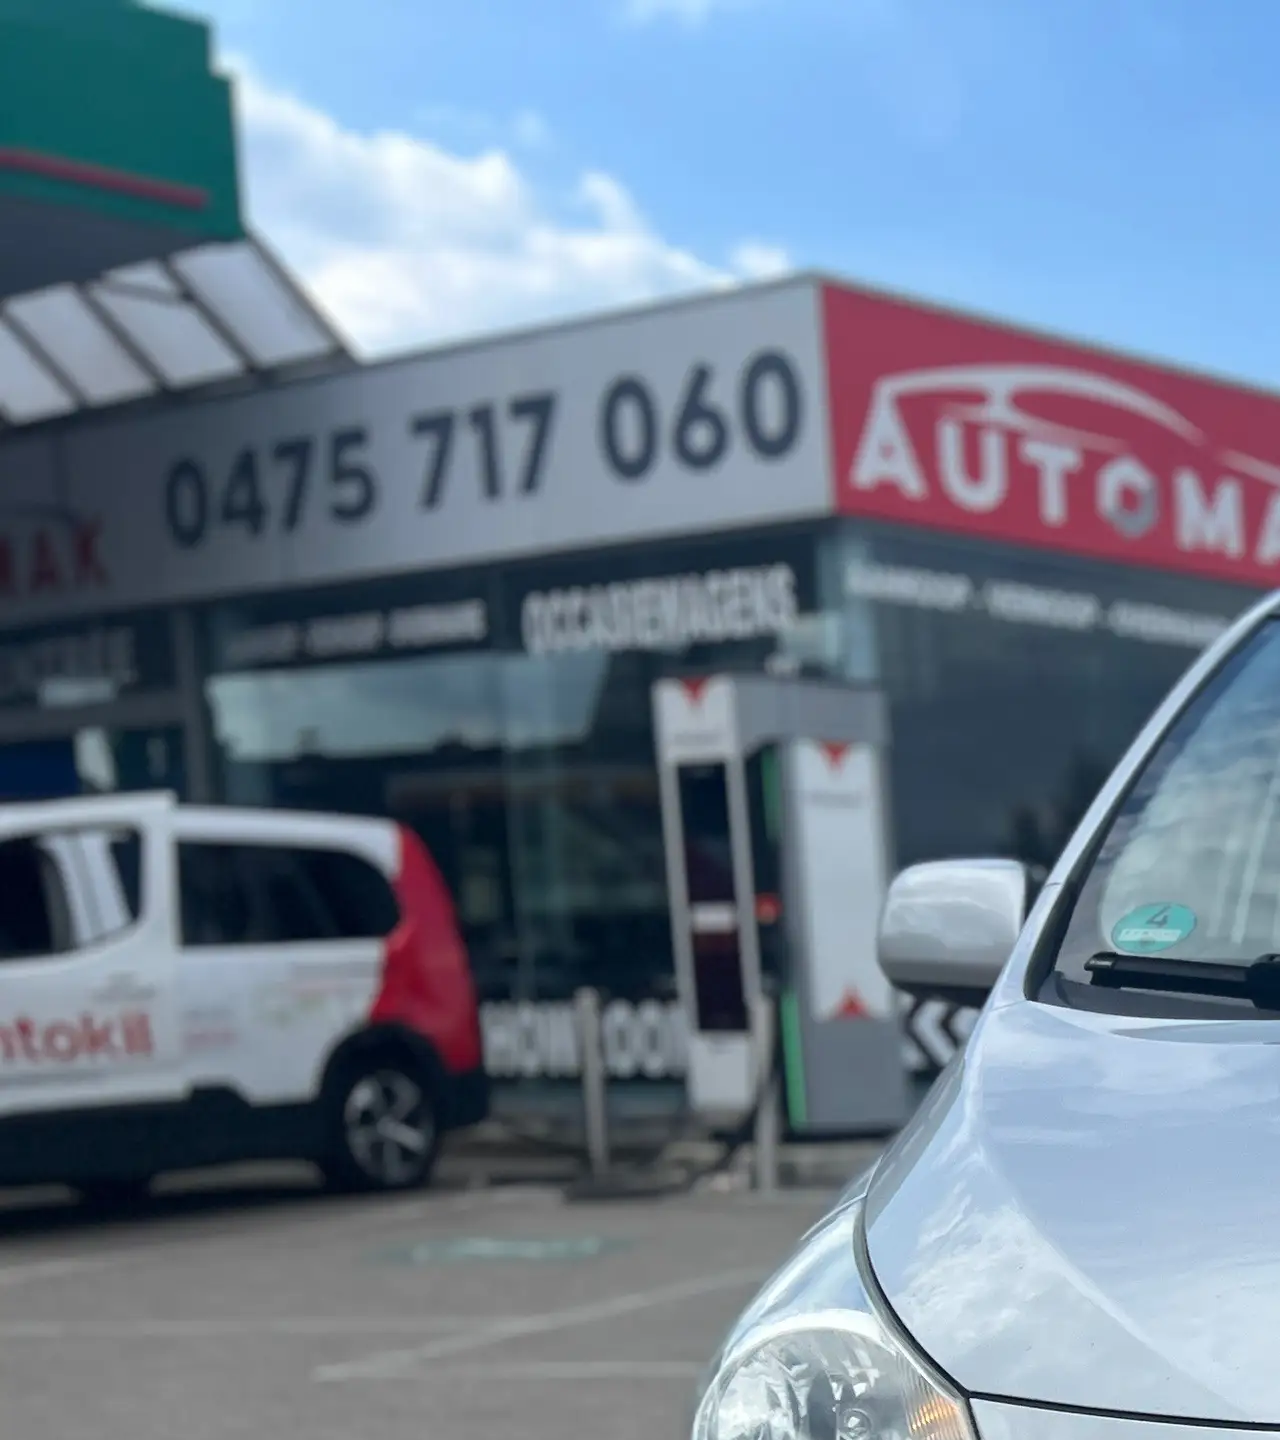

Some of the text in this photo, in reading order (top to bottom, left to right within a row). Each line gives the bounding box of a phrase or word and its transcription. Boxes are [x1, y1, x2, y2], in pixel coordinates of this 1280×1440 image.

[165, 349, 803, 548] 0475 717 060
[1145, 904, 1172, 929] 4
